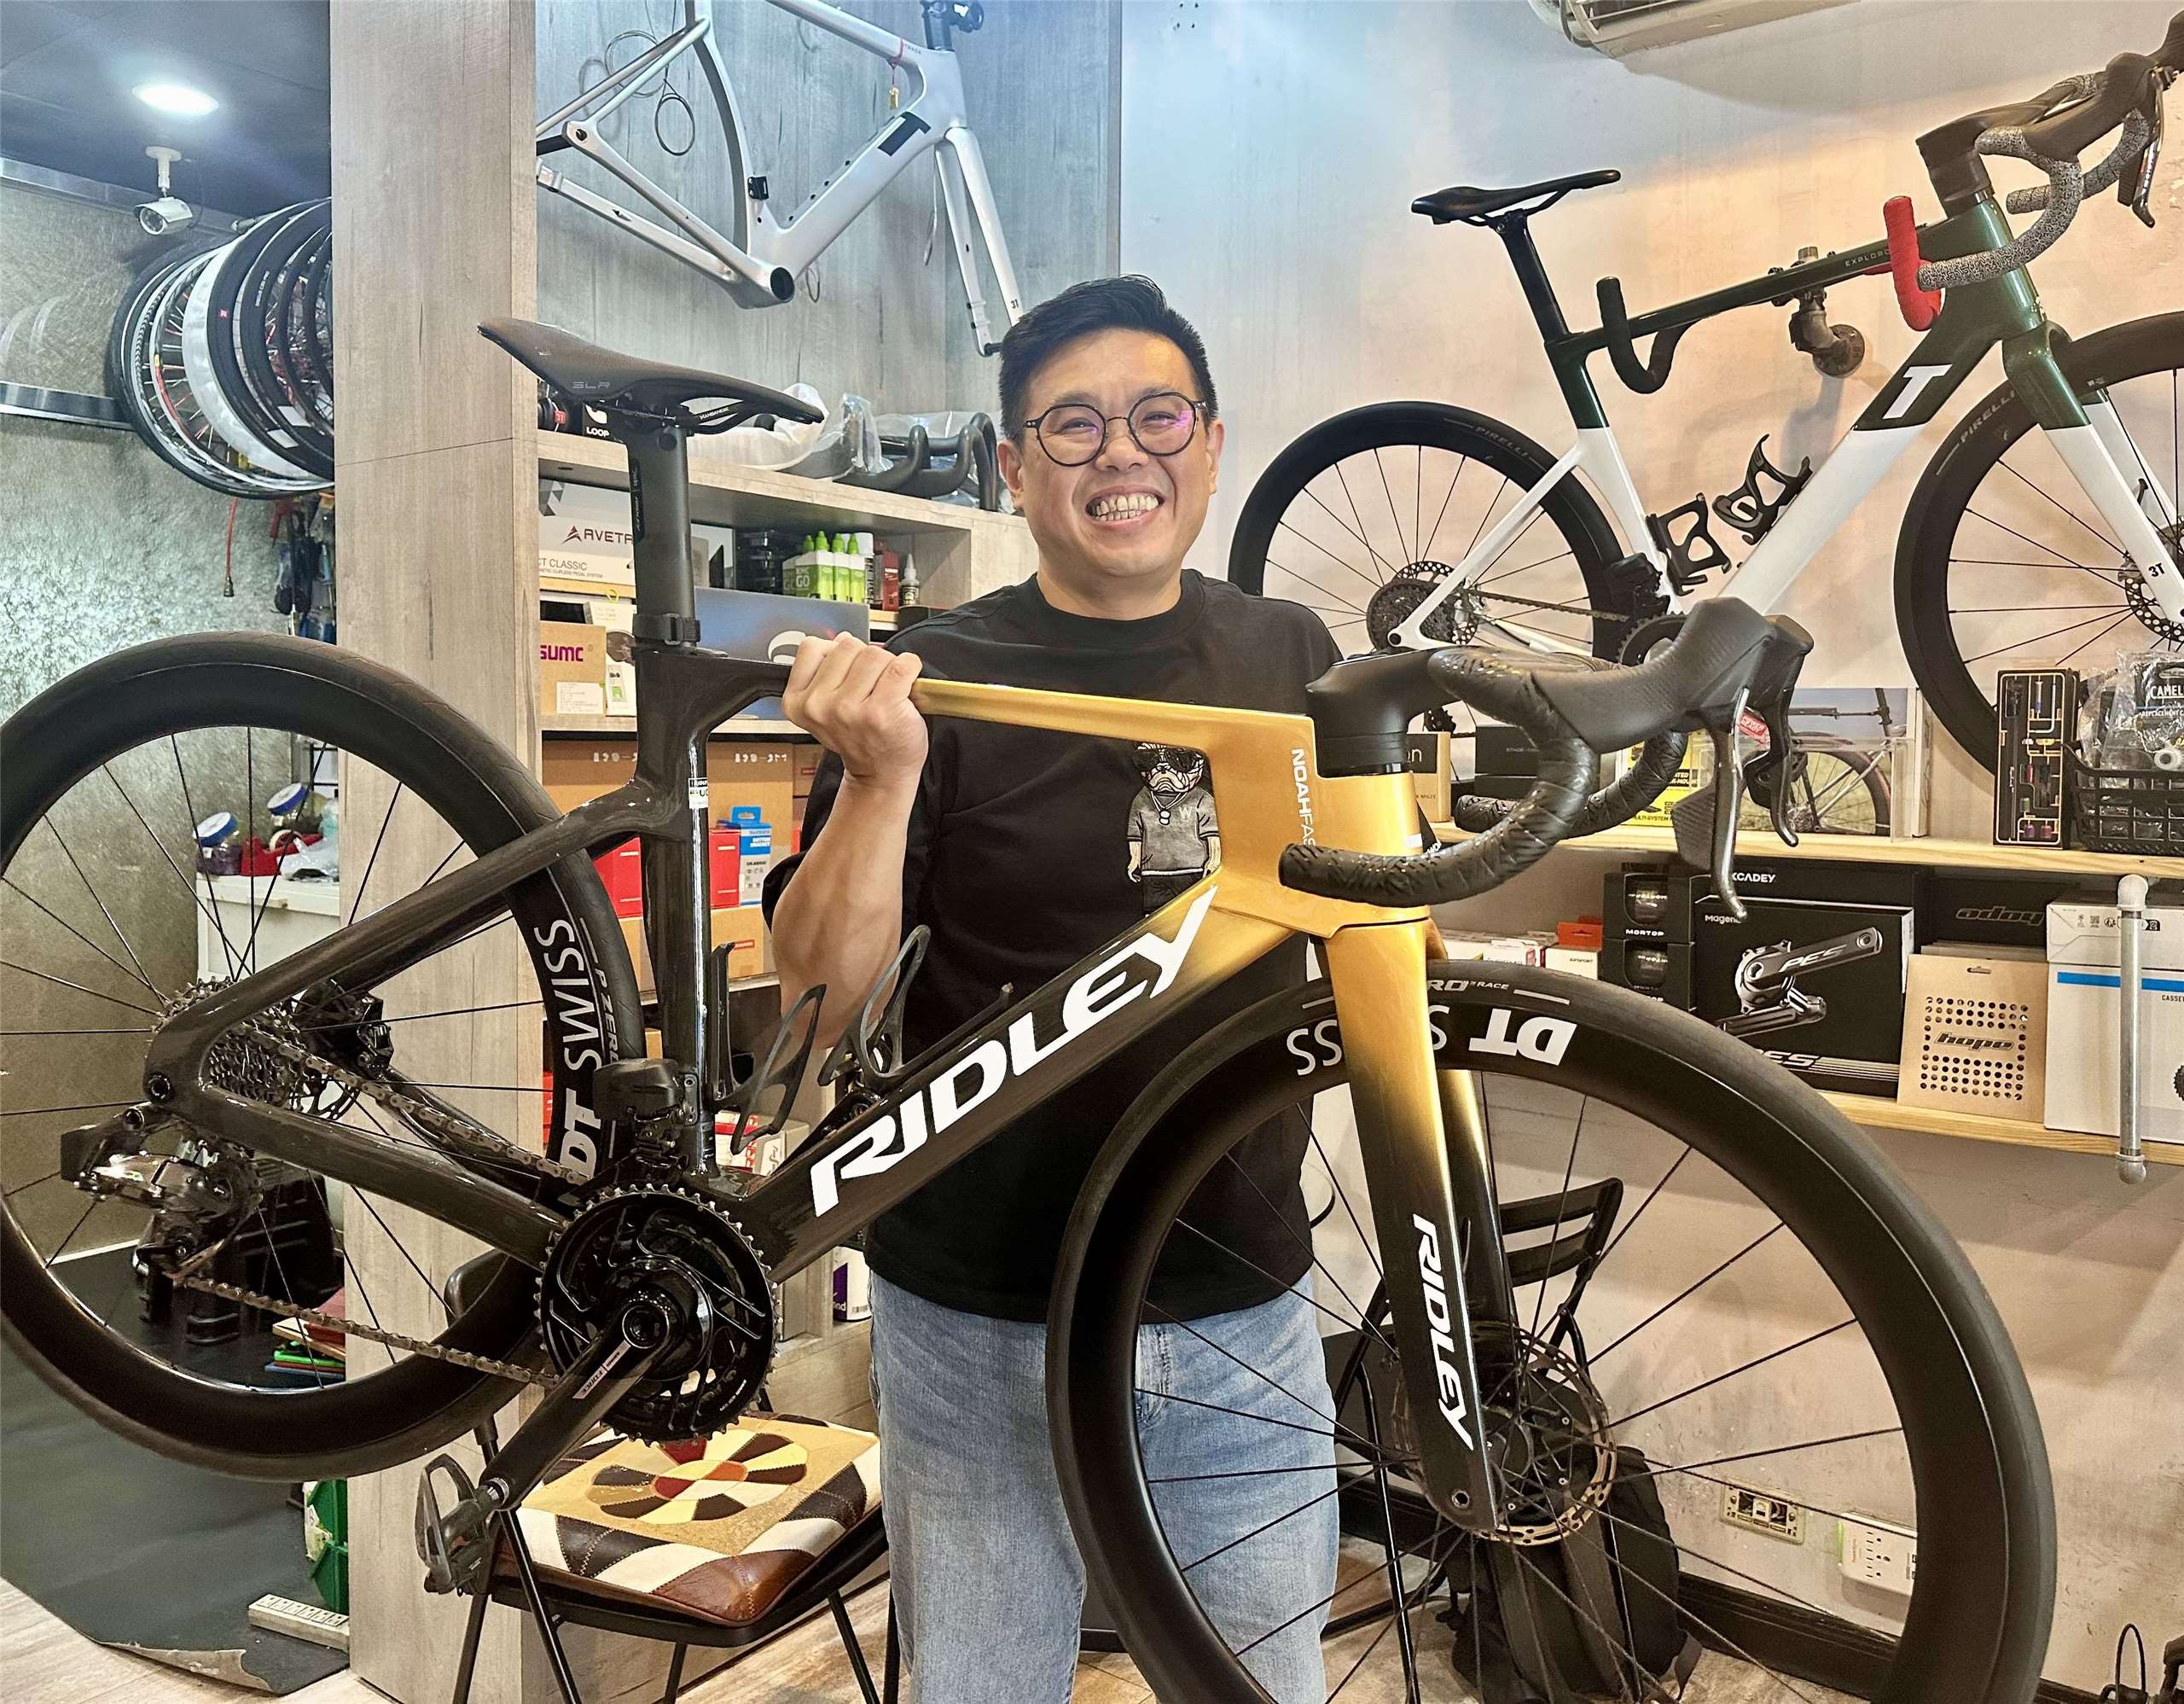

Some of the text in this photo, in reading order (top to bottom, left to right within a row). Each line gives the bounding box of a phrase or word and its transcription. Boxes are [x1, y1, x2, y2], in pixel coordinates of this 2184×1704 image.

[1960, 389, 2016, 444] PIRELLI
[586, 427, 610, 437] LOOP
[549, 558, 588, 572] CLASSIC
[2148, 562, 2165, 578] 3T
[796, 575, 810, 588] GO
[1477, 981, 1509, 991] RACE
[534, 919, 602, 1180] DT SWISS
[1286, 1004, 1577, 1076] DT SSS
[1934, 1032, 2015, 1051] hope
[810, 884, 1218, 1218] RIDLEY
[1413, 1213, 1474, 1451] RIDLEY
